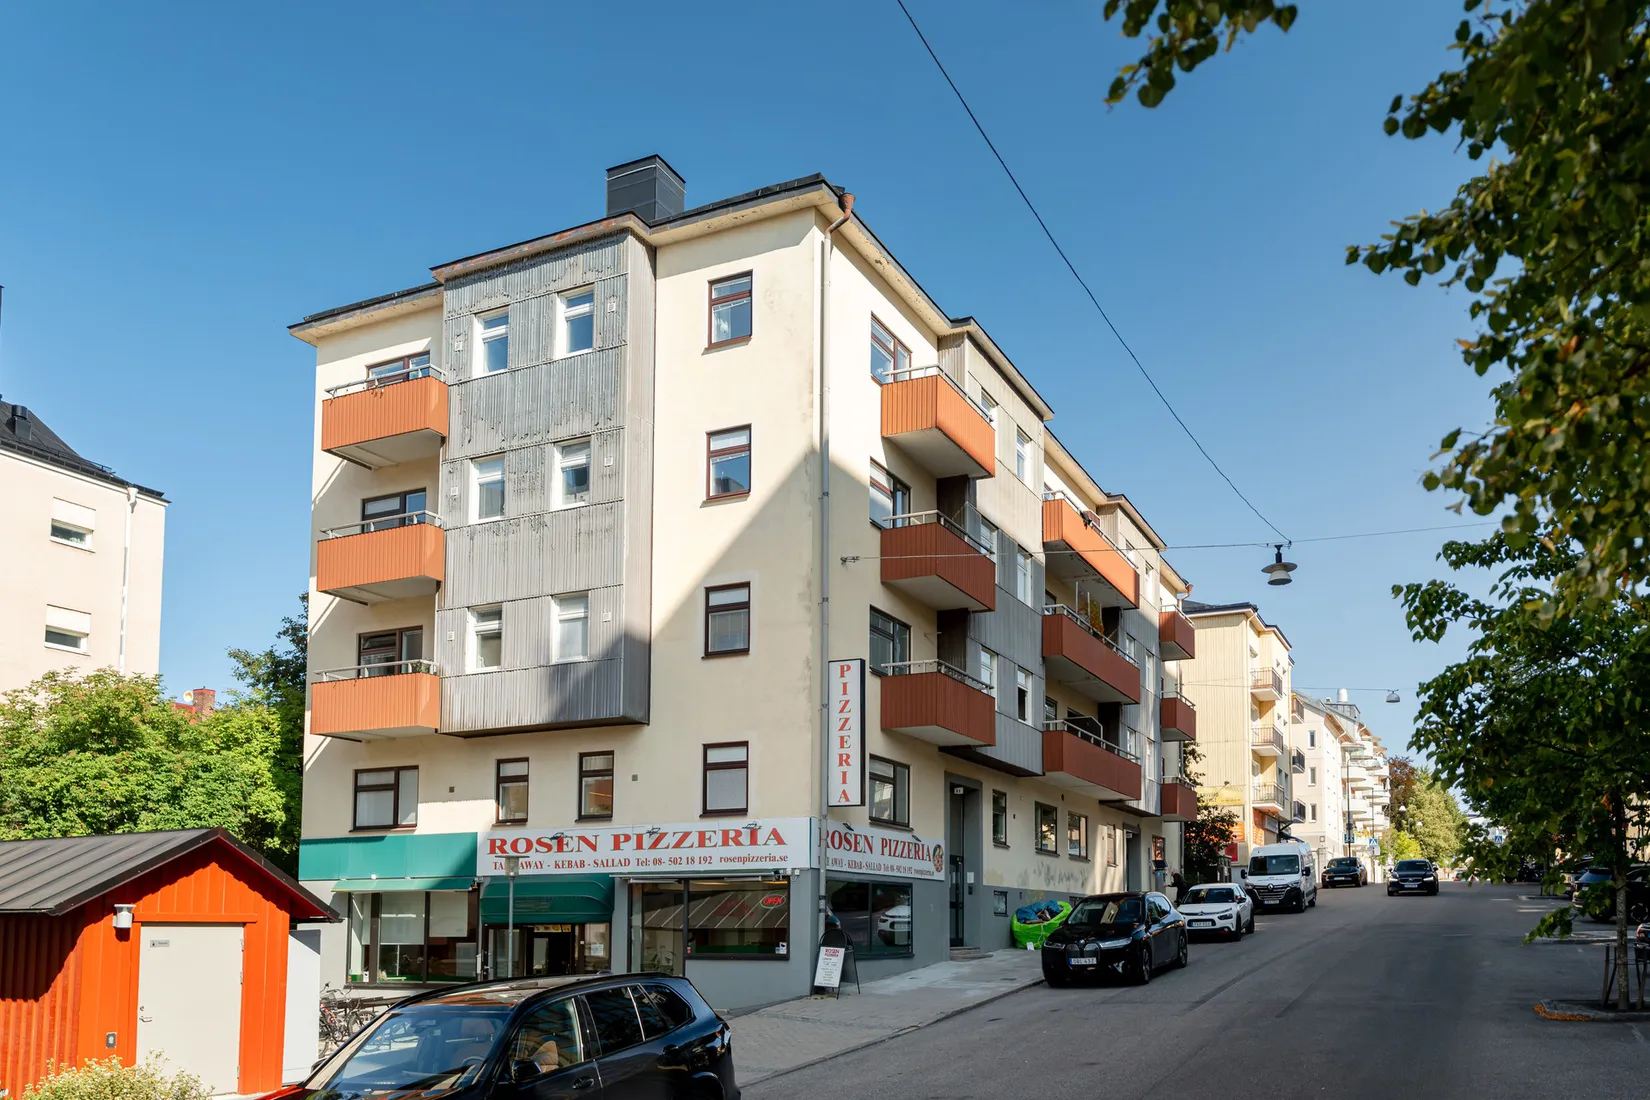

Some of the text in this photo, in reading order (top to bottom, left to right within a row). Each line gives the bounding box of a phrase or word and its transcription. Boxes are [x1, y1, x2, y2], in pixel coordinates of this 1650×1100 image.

[837, 663, 852, 803] PIZZERIA
[487, 827, 787, 855] ROSEN PIZZERIA
[880, 837, 932, 862] PIZZERIA
[519, 860, 545, 870] AWAY
[554, 859, 585, 869] KEBAB
[593, 858, 630, 868] SALLAD
[635, 857, 650, 867] Tel:
[652, 857, 665, 866] 08-
[668, 857, 682, 866] 502
[686, 856, 695, 865] 18
[698, 855, 712, 865] 192
[719, 853, 788, 865] rosenpizzeria.se
[763, 896, 783, 905] OPEN
